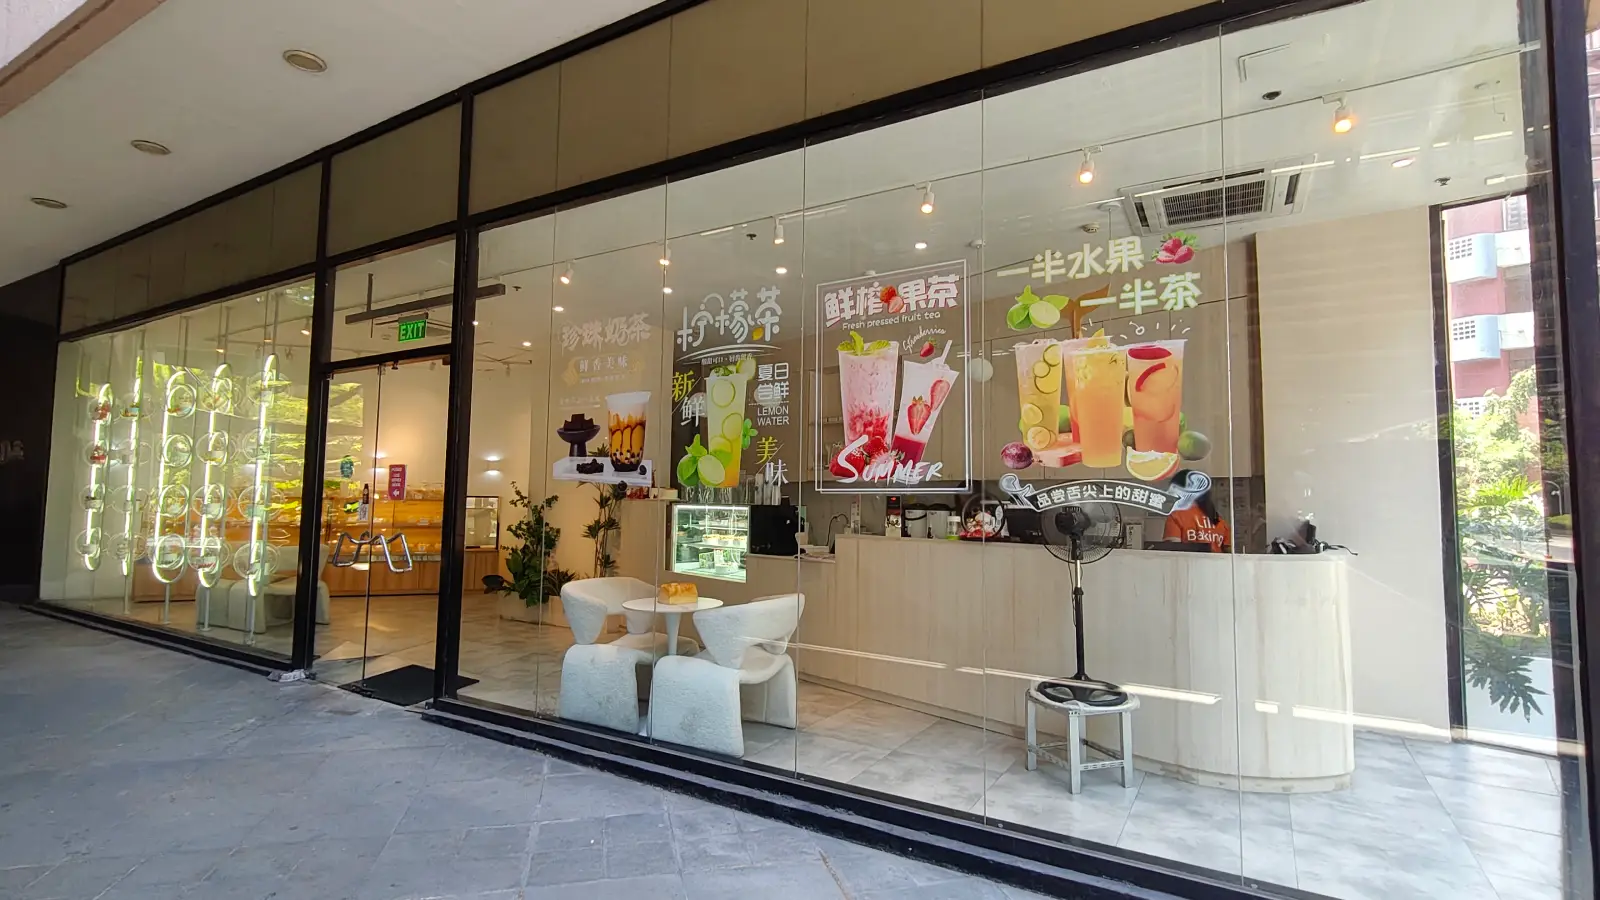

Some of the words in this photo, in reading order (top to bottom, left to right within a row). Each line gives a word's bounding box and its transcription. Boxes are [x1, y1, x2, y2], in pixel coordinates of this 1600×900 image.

[996, 235, 1145, 284] 一半水果
[824, 274, 960, 328] 鲜榨果茶
[1079, 271, 1203, 315] 一半茶
[399, 322, 425, 340] EXIT
[676, 285, 783, 352] 柠檬茶
[842, 320, 866, 331] Fresh
[867, 315, 900, 329] pressed
[901, 313, 922, 323] fruit
[924, 311, 941, 320] tea
[560, 312, 651, 357] 珍珠奶茶
[757, 362, 789, 381] 夏日
[671, 370, 706, 427] 新鲜
[757, 381, 789, 400] 尝鲜
[757, 405, 789, 416] LEMON
[757, 416, 789, 426] WATER
[755, 436, 789, 487] 美味
[1036, 484, 1167, 510] 品尝舌尖上的甜蜜
[1187, 529, 1224, 547] Baking
